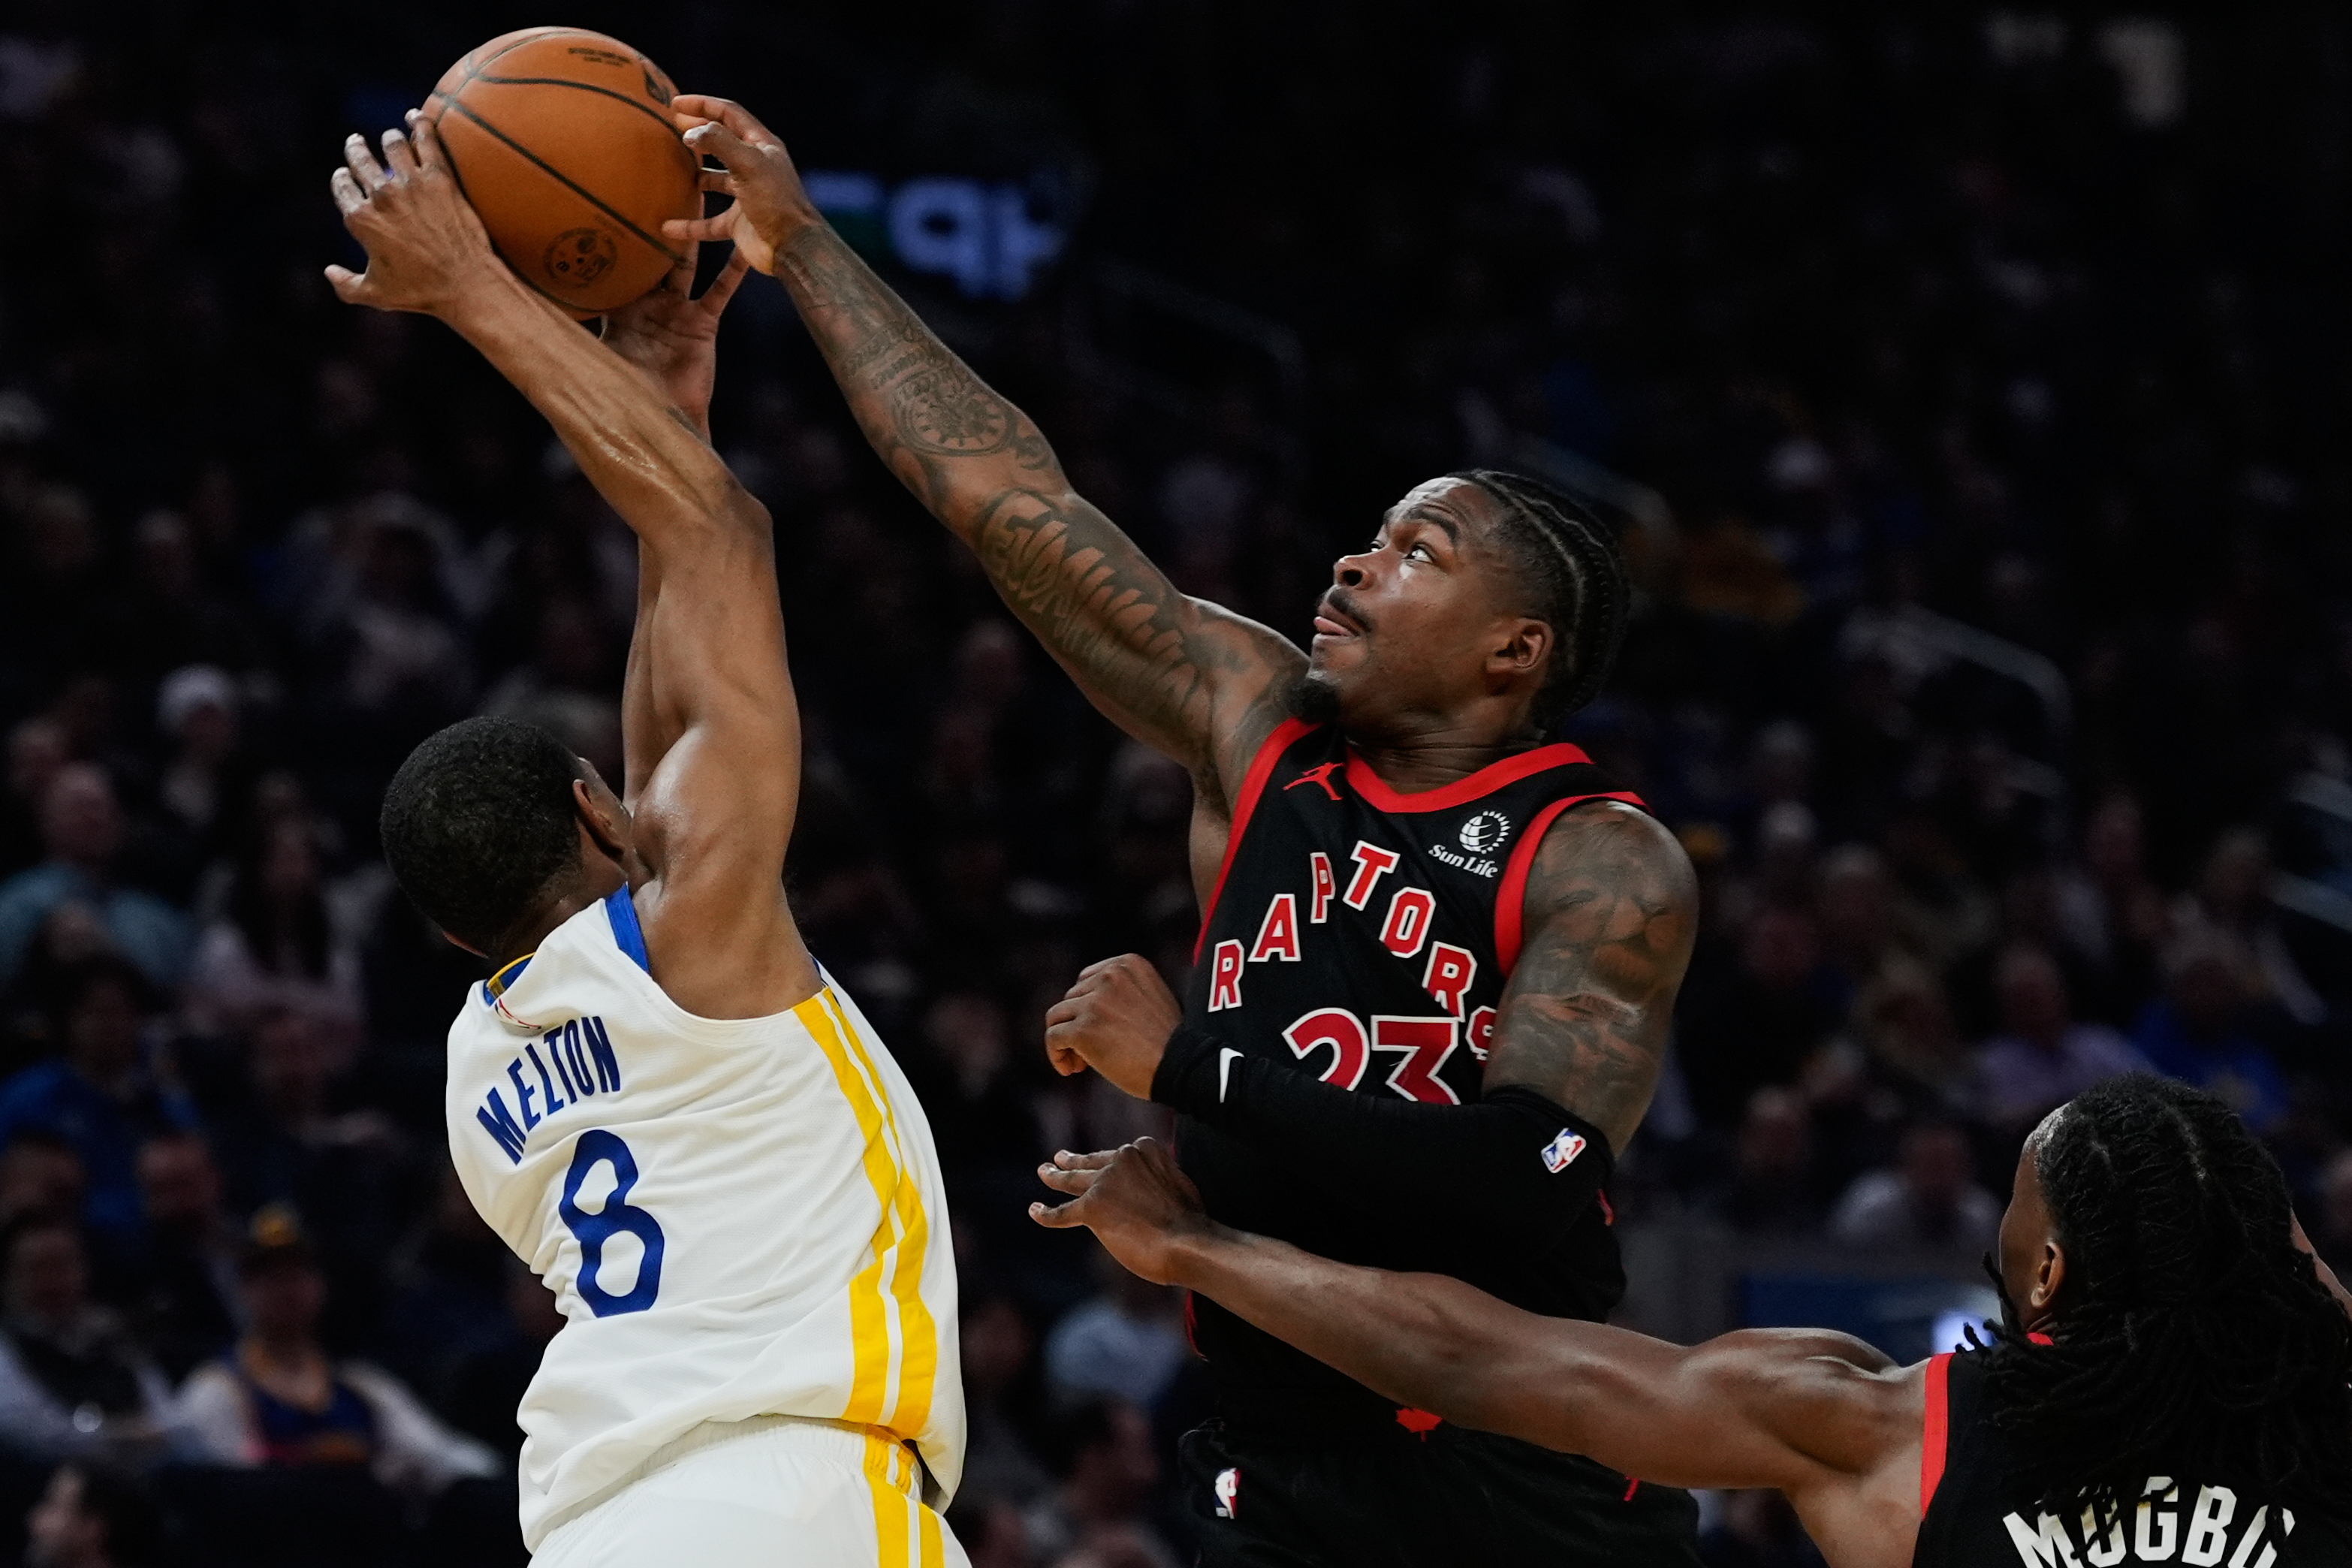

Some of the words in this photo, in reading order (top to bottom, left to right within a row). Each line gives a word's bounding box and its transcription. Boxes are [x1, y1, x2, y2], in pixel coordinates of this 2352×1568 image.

[1428, 844, 1465, 867] Sun
[1463, 857, 1498, 878] Life
[476, 1015, 621, 1166] MELTON
[1281, 1007, 1461, 1105] 23
[559, 1129, 665, 1319] 8
